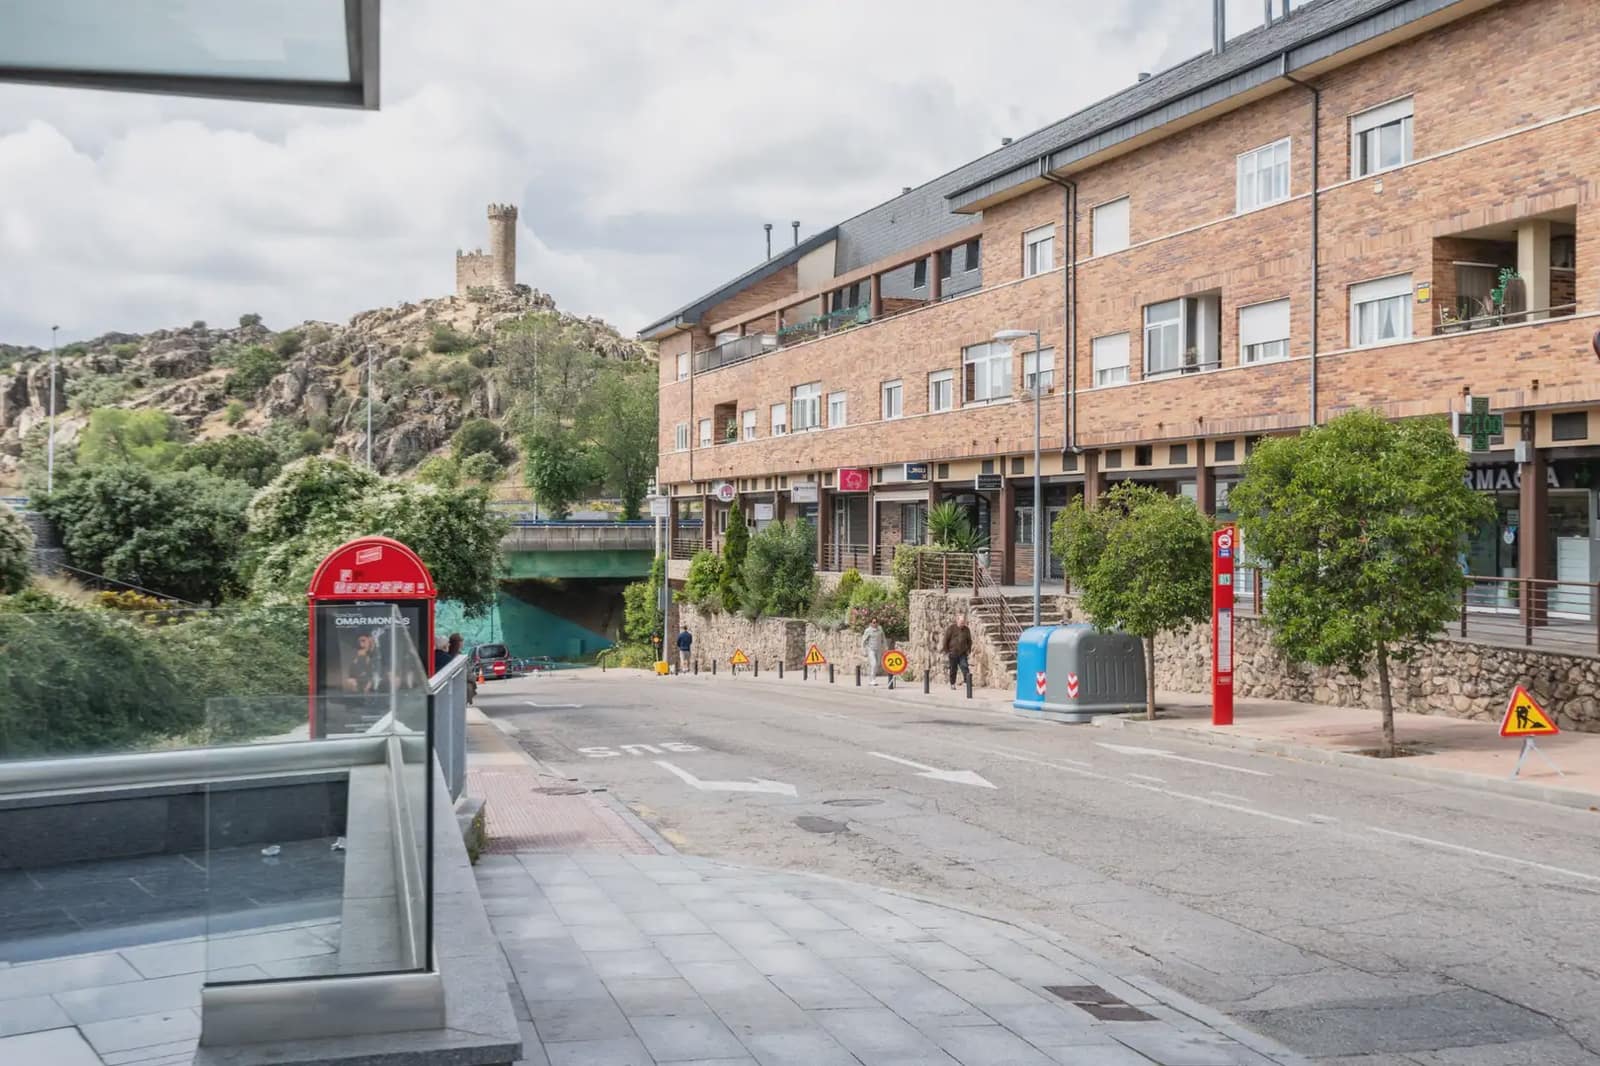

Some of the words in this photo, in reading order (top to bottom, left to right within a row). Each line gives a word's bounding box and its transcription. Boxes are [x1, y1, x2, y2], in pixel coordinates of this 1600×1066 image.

[335, 617, 367, 625] OMAR
[368, 617, 410, 625] MONS
[888, 657, 903, 667] 20
